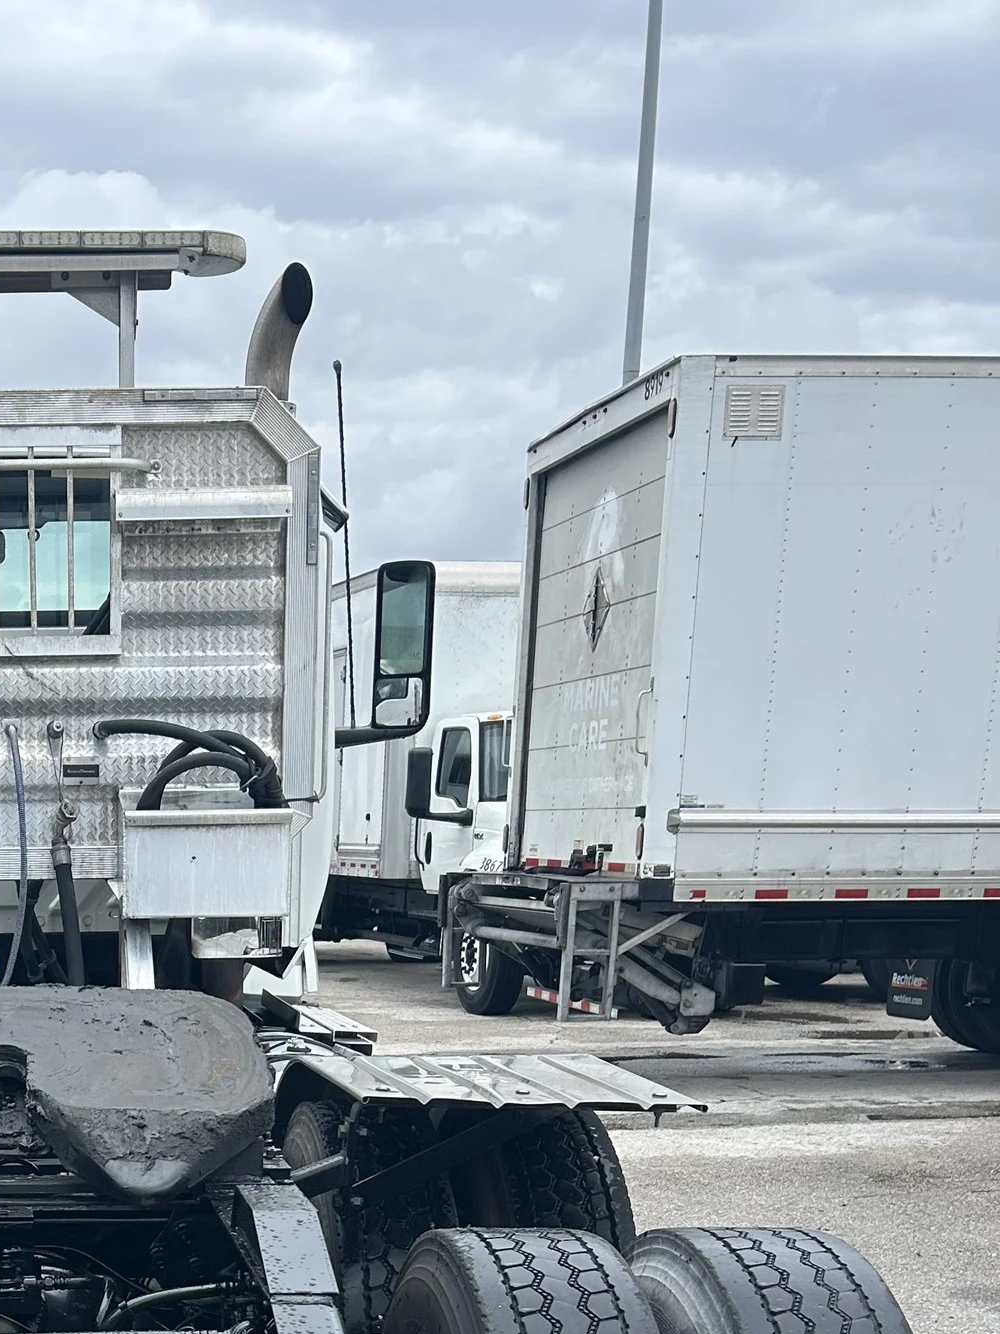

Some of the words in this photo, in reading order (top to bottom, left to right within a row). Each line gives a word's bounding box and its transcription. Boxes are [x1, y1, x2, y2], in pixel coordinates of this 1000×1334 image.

[645, 371, 664, 401] 8919
[563, 675, 620, 713] MARINE
[569, 718, 608, 753] CARE
[480, 857, 504, 872] 3867
